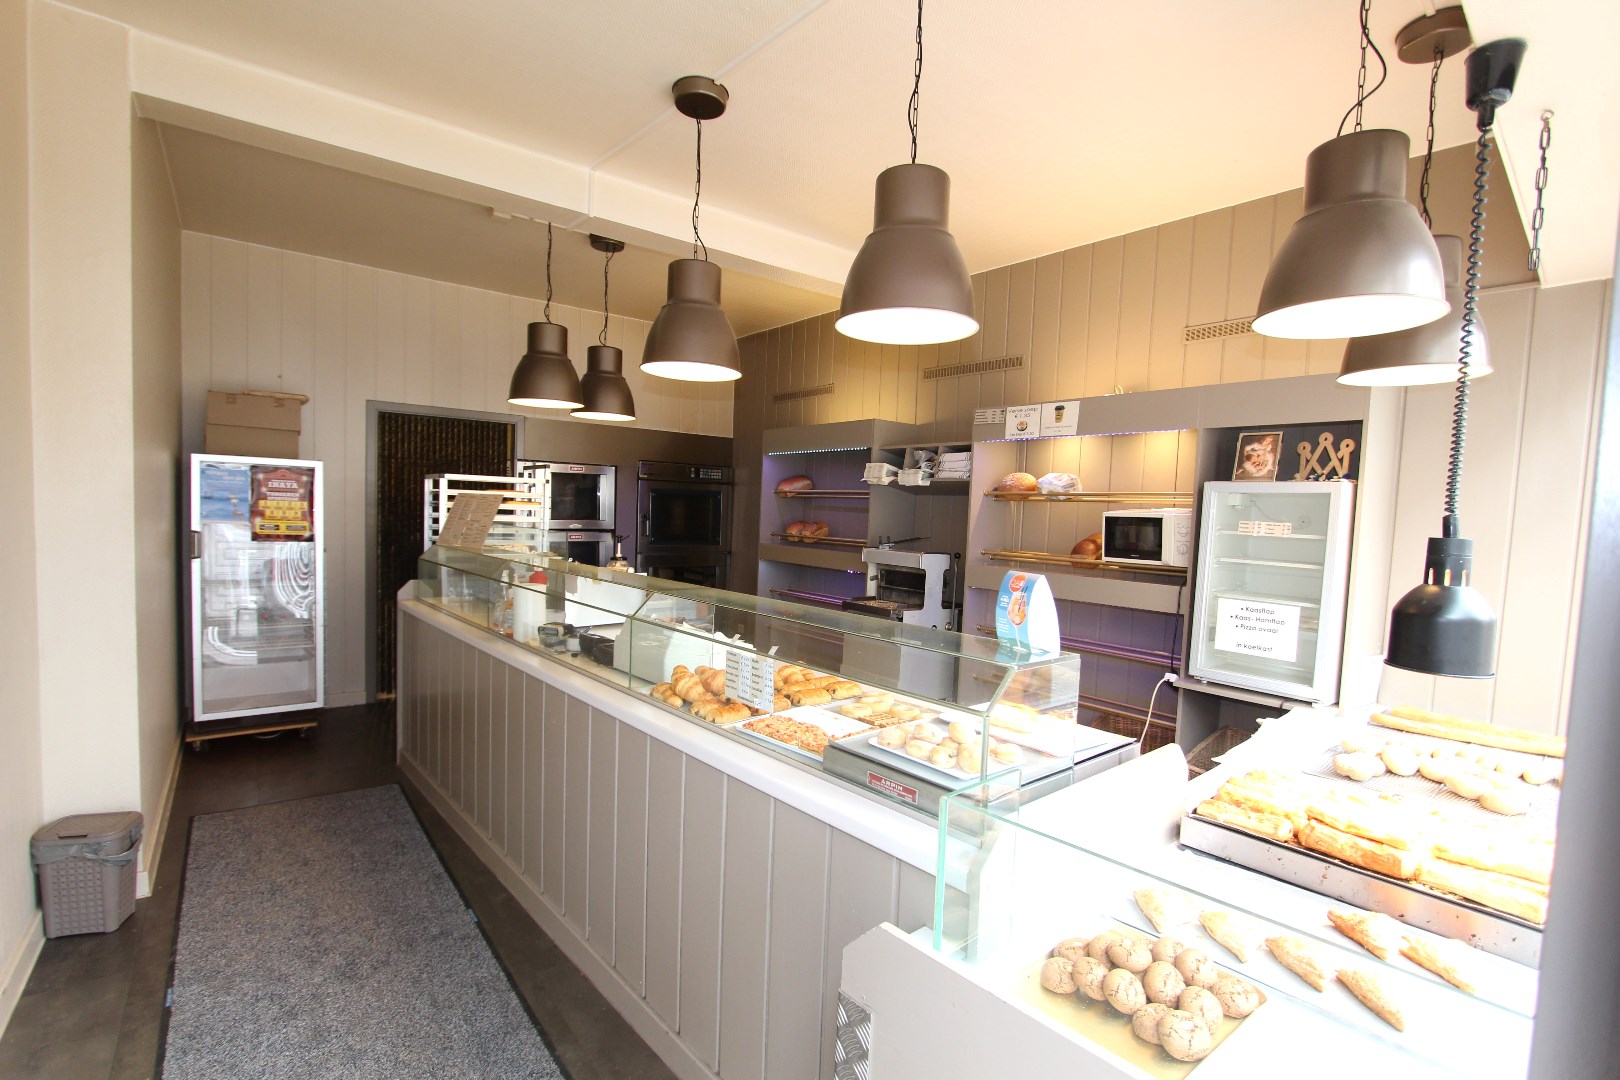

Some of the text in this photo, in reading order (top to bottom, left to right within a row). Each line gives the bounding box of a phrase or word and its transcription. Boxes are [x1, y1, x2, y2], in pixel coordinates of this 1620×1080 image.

[1245, 606, 1275, 615] Kaasflap
[1240, 623, 1257, 631] Pizza
[1243, 643, 1273, 652] koelkast
[880, 778, 903, 792] ARPIN
